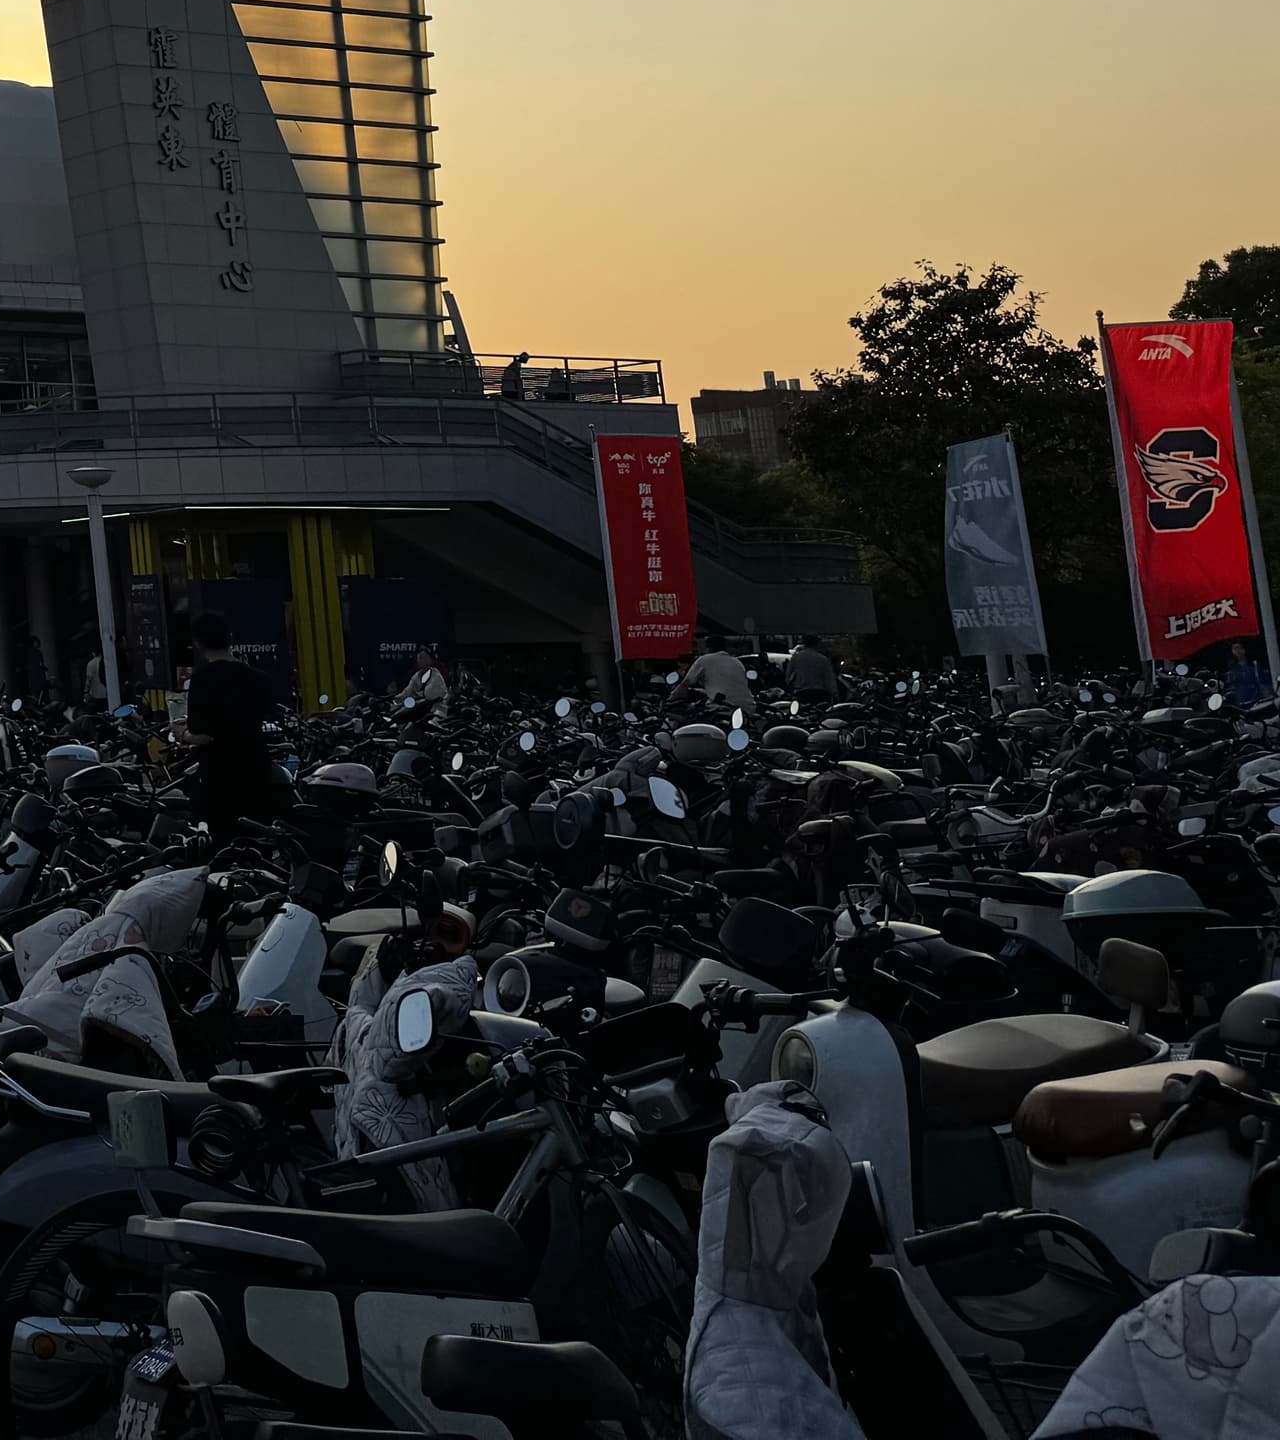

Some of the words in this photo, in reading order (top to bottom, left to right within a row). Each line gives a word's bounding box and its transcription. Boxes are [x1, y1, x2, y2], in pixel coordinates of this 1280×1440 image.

[147, 25, 190, 171] 霍英東
[207, 100, 254, 293] 體育中心
[1138, 346, 1172, 361] ANTA
[638, 482, 657, 522] 你真牛
[643, 528, 663, 583] 红牛挺你
[1163, 598, 1239, 640] 上海交大
[229, 643, 278, 653] ARTSHOT
